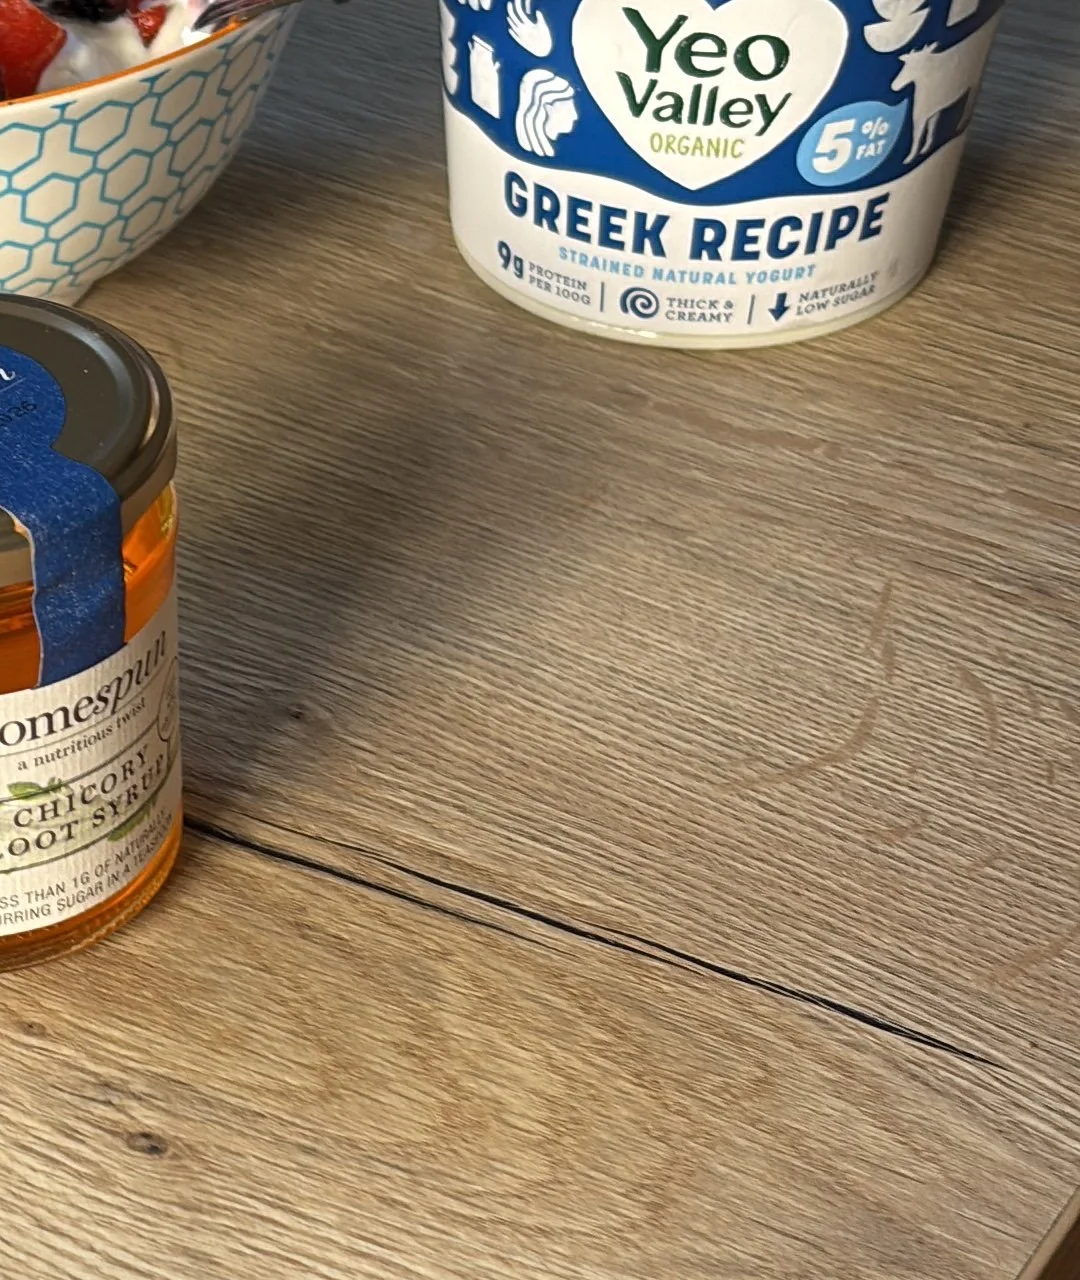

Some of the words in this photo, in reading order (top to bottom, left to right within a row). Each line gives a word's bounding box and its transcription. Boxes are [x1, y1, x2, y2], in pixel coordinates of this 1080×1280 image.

[621, 6, 790, 81] Yeo
[616, 71, 792, 136] Valley
[649, 132, 746, 159] ORGANIC
[854, 141, 886, 161] FAT
[504, 170, 670, 260] GREEK
[689, 192, 891, 262] RECIPE
[497, 241, 524, 279] 9g
[528, 262, 588, 291] PROTEIN
[558, 246, 646, 279] STRAINED
[651, 268, 738, 286] NATURAL
[745, 263, 817, 286] YOGURT
[528, 278, 553, 297] PER
[554, 286, 592, 307] 100G
[665, 297, 719, 310] THICK
[723, 299, 734, 311] &
[795, 300, 831, 317] LOW
[831, 284, 876, 308] SUGAR
[798, 270, 880, 303] NATURALLY
[665, 308, 734, 324] CREAMY
[17, 760, 28, 771] a
[34, 726, 113, 767] nutritious
[117, 696, 147, 731] twist
[13, 744, 150, 827] CHICORY
[92, 753, 165, 829] SYRUP
[26, 880, 67, 903] THAN
[72, 871, 91, 888] 1G
[95, 857, 112, 878] OF
[57, 882, 104, 913] SUGAR
[107, 870, 122, 888] IN
[123, 863, 133, 879] A
